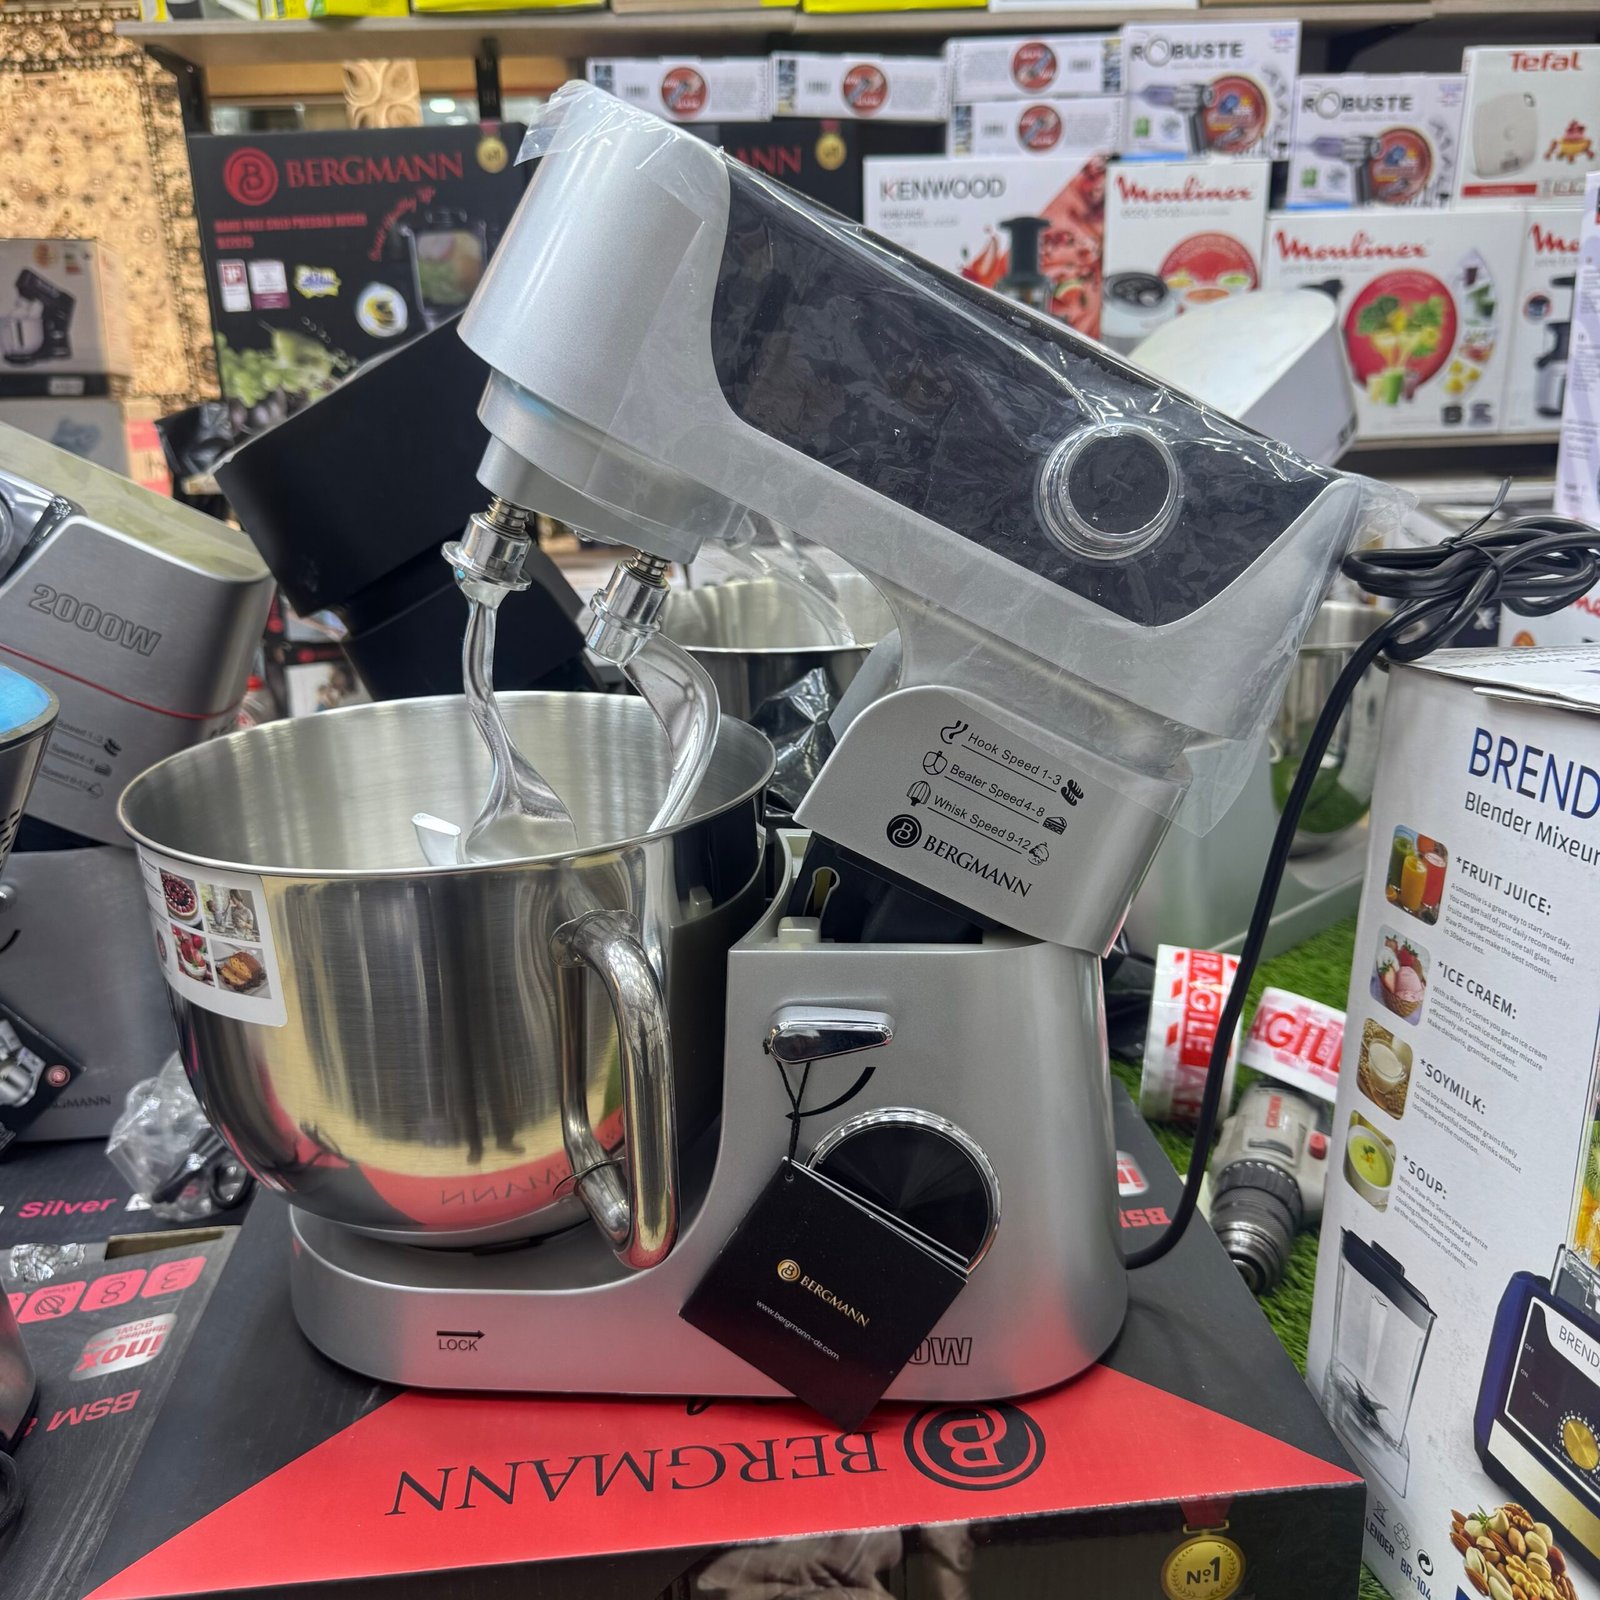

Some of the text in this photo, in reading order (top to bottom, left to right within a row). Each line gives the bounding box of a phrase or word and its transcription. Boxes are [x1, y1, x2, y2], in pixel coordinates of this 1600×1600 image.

[1130, 35, 1245, 67] ROBUSTE
[1509, 51, 1583, 73] Tefal
[1301, 89, 1414, 120] ROBUSTE
[286, 153, 464, 189] BERGMANN
[880, 176, 1007, 201] KENWOOD
[29, 584, 162, 657] 2000W
[967, 732, 1063, 786] Hook Speed 1-3
[949, 763, 988, 790] Beater
[988, 784, 1025, 808] Speed
[933, 794, 1032, 850] Whisk Speed 9-12
[1464, 791, 1532, 835] Blender
[922, 834, 1032, 898] BERGMANN
[1449, 893, 1460, 904] You
[1460, 900, 1470, 909] can
[1470, 906, 1480, 915] get
[1480, 909, 1493, 921] half
[1498, 921, 1513, 932] your
[1513, 927, 1529, 942] daily
[1456, 886, 1482, 903] smoothie
[1492, 904, 1508, 916] great
[1508, 912, 1520, 924] way
[1528, 922, 1543, 934] start
[1542, 930, 1558, 942] your
[1503, 882, 1552, 916] JUICE:
[1445, 915, 1558, 982] Raw Pro series make the best smoothies
[1447, 905, 1463, 918] fruits
[1463, 914, 1474, 924] and
[1474, 920, 1504, 940] vegetables
[1511, 940, 1523, 950] one
[1524, 945, 1534, 956] tall
[1466, 979, 1517, 1020] CRAEM:
[18, 1198, 118, 1219] Silver
[800, 1275, 871, 1328] BERGMANN
[438, 1338, 479, 1352] LOCK
[756, 1299, 841, 1361] www.bergmann-dz.com
[76, 1334, 165, 1372] inox
[46, 1389, 142, 1432] BSM
[385, 1430, 887, 1516] BERGMANN
